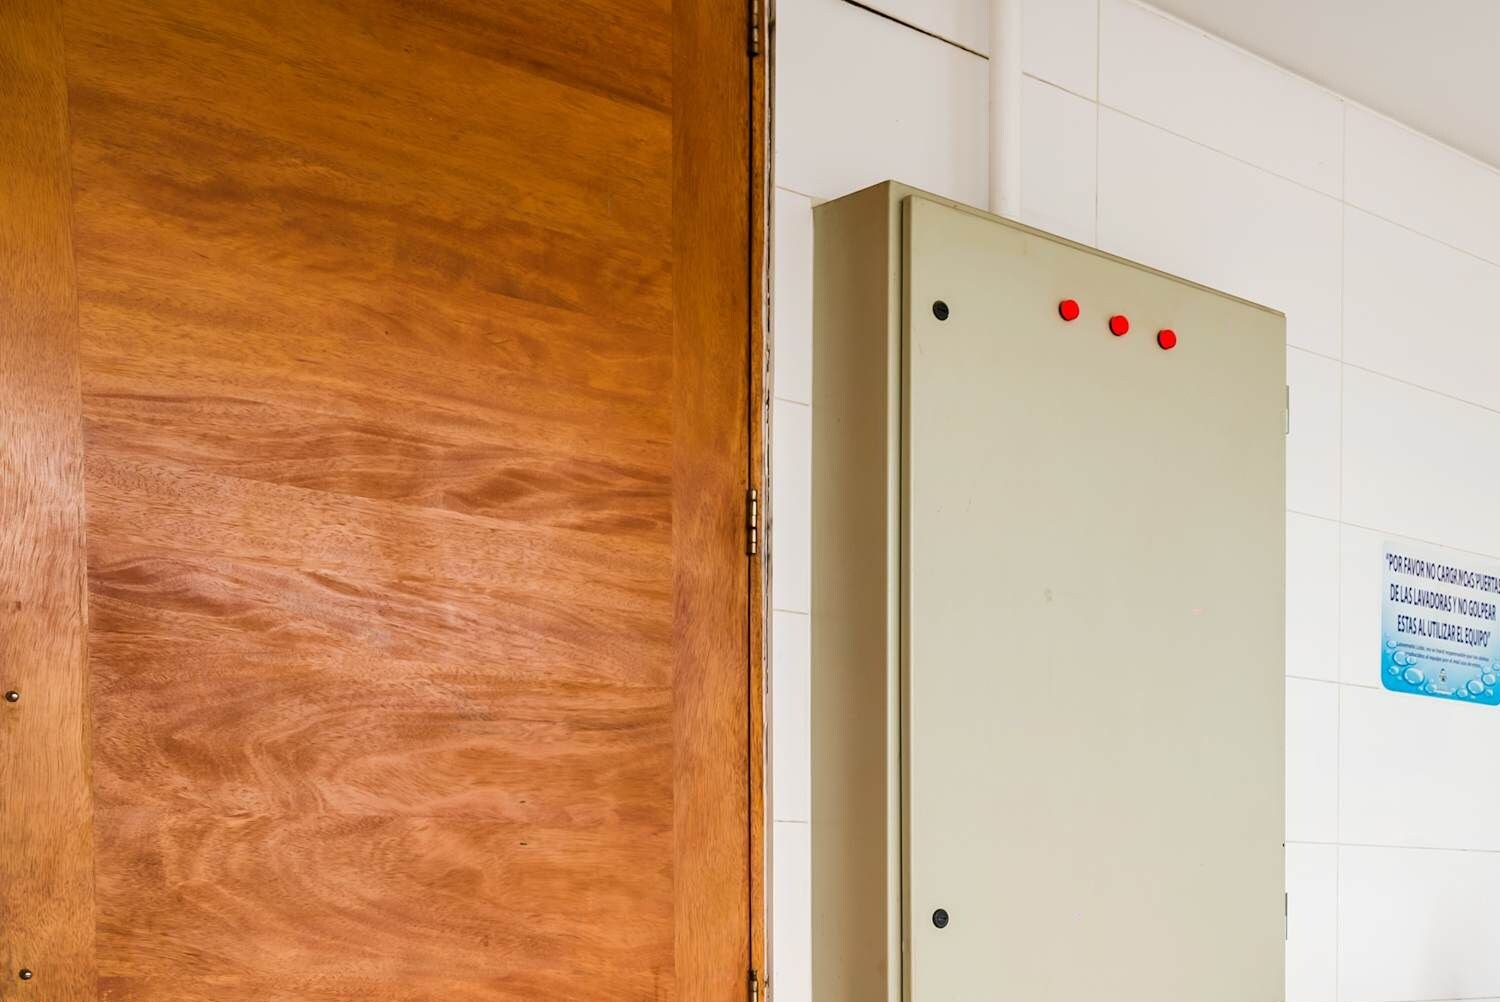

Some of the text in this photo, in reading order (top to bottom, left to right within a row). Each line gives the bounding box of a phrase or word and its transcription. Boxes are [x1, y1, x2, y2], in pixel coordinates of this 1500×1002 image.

[1403, 556, 1424, 578] FAVOR
[1426, 561, 1435, 580] NO
[1390, 583, 1495, 620] DE LAS LAVADORAS Y NO GOLPEAR
[1398, 614, 1416, 635] ESTAS
[1418, 618, 1425, 636] AL
[1427, 619, 1455, 641] UTILIZAR
[1457, 625, 1463, 643] EL
